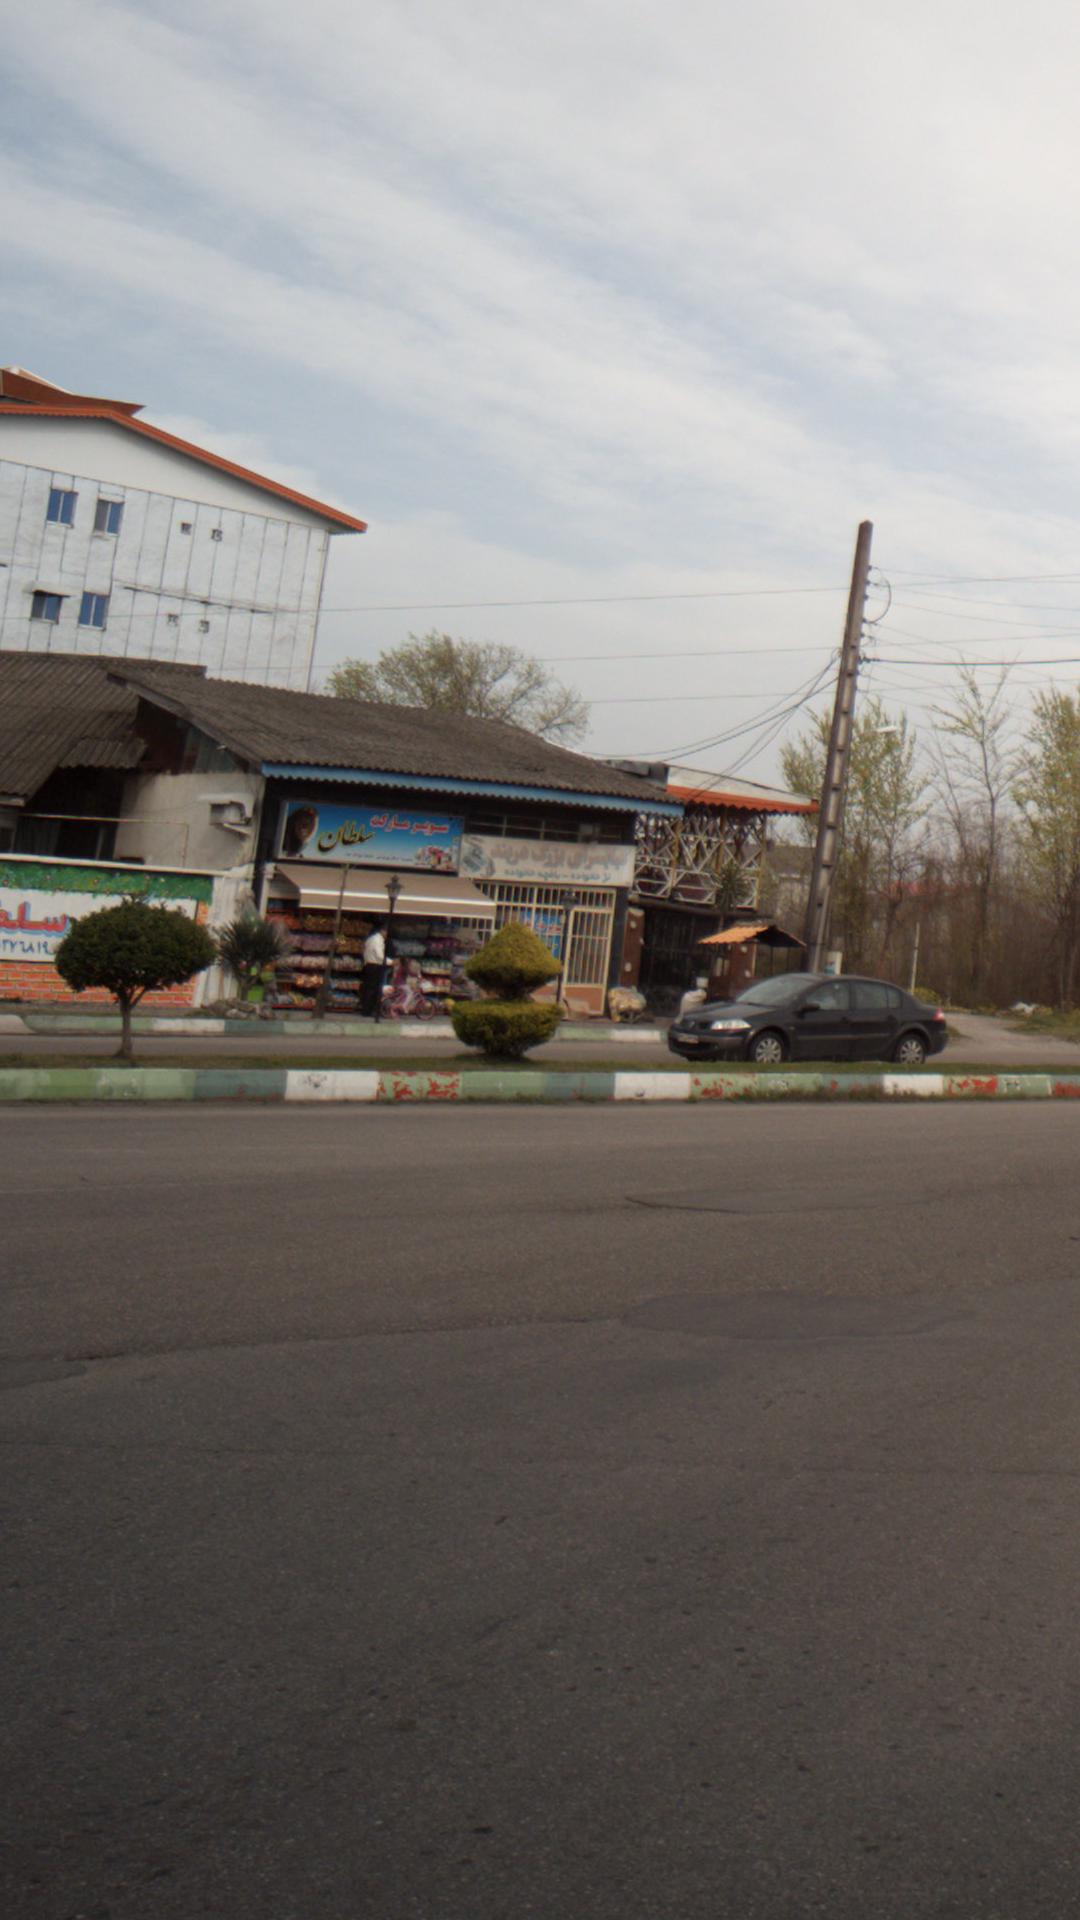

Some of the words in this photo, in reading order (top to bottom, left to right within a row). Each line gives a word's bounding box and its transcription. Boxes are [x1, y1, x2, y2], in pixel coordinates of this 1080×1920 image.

[370, 813, 410, 833] مارکت
[411, 819, 449, 835] سوپر
[317, 819, 375, 853] سلطان
